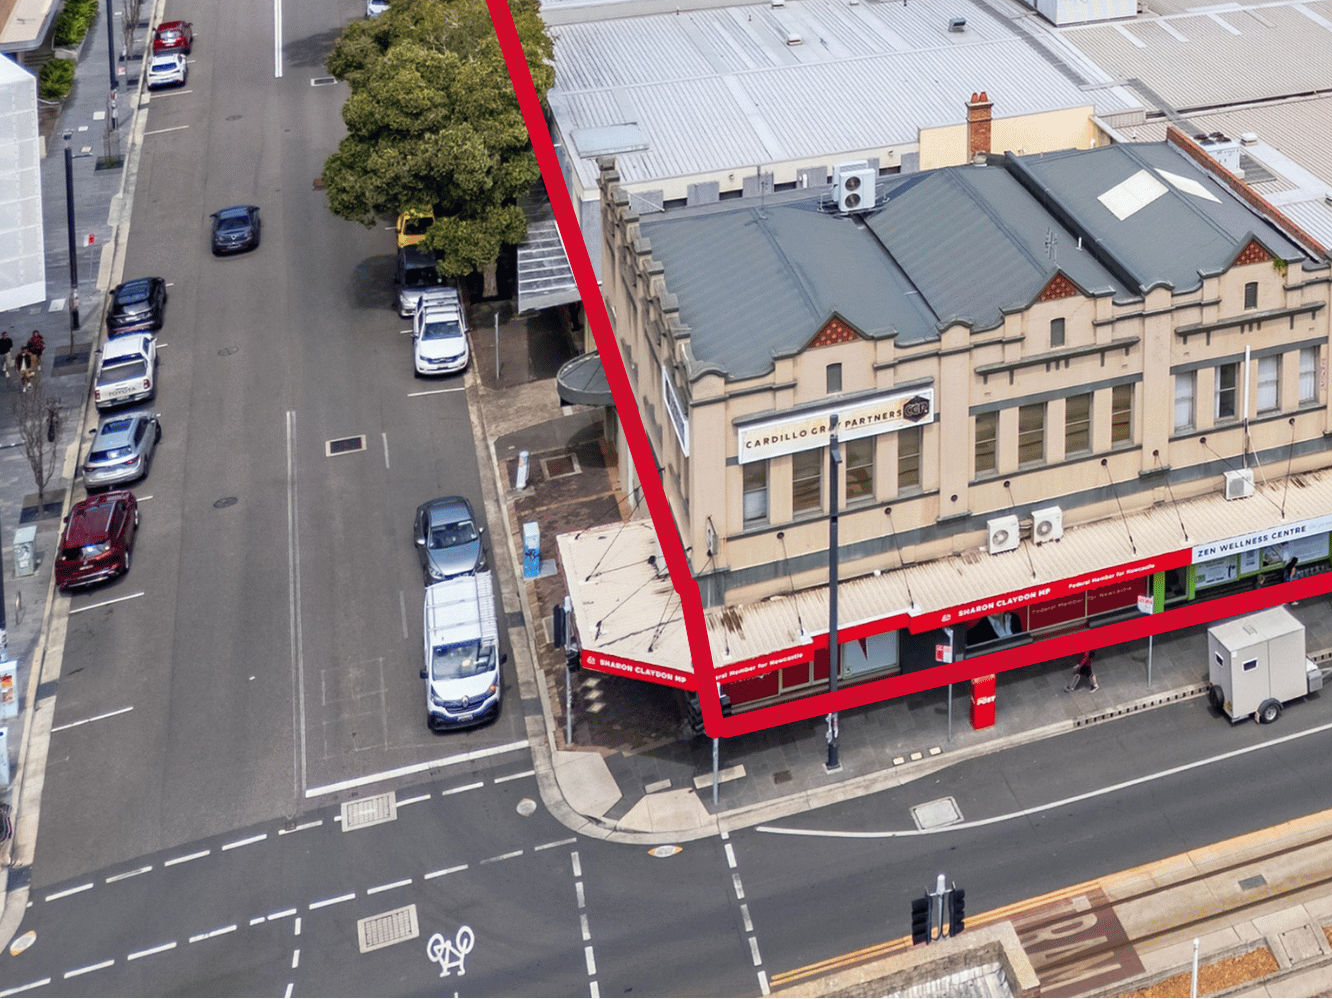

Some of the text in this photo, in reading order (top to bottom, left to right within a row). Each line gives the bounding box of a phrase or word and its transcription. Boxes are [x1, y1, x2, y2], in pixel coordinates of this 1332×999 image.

[108, 387, 137, 397] TOYOTA
[746, 430, 807, 449] CARDILLO
[845, 409, 902, 428] PARTNERS
[1198, 525, 1307, 557] ZEN WELLNESS CENTRE
[958, 601, 994, 617] SHARON
[996, 591, 1037, 608] CLAYDON
[1038, 587, 1051, 598] MP
[600, 659, 687, 684] SHARON CLAYDON MP
[729, 665, 756, 676] Member
[769, 653, 803, 666] Newcastle
